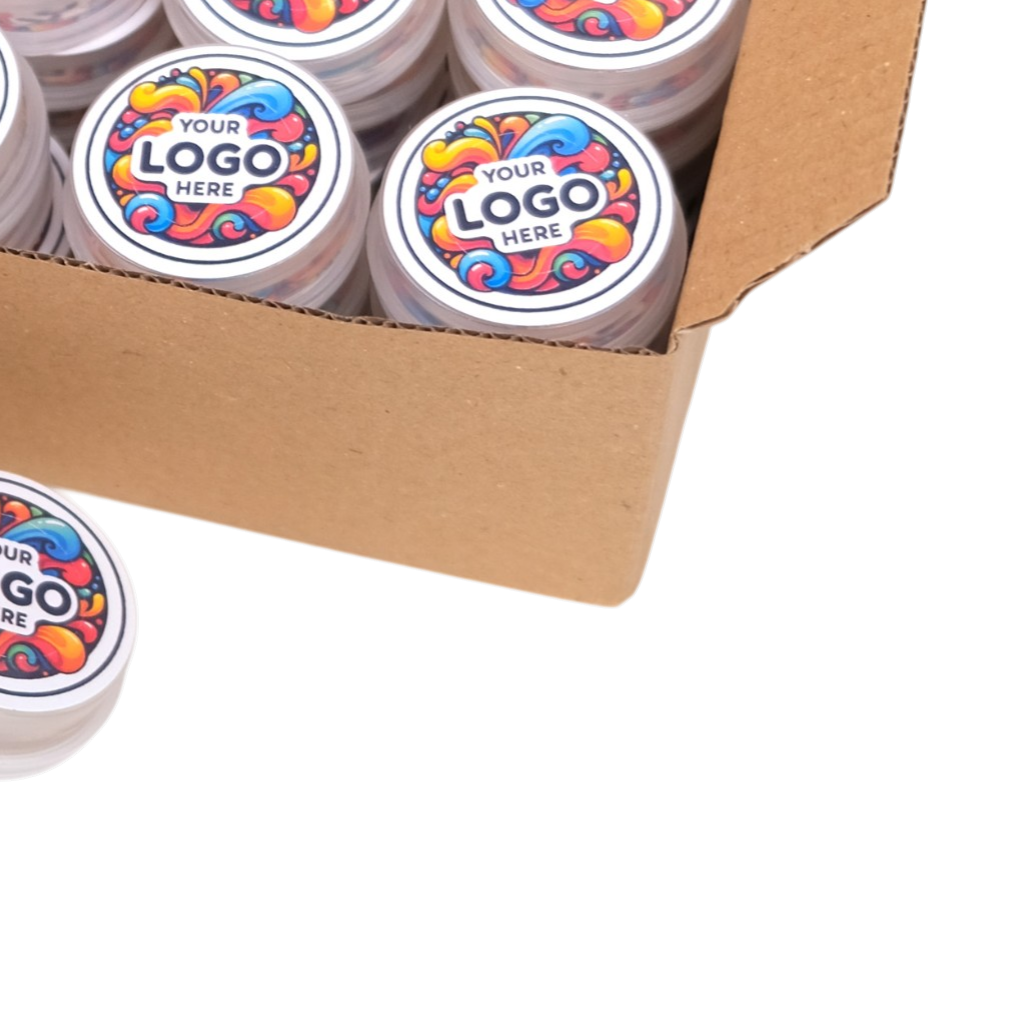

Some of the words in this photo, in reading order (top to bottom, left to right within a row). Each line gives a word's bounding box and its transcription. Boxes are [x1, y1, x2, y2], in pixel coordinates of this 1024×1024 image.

[179, 118, 241, 135] YOUR
[139, 140, 282, 178] LOGO
[481, 160, 546, 183] YOUR
[176, 180, 234, 197] HERE
[452, 177, 600, 232] LOGO
[501, 222, 563, 246] HERE
